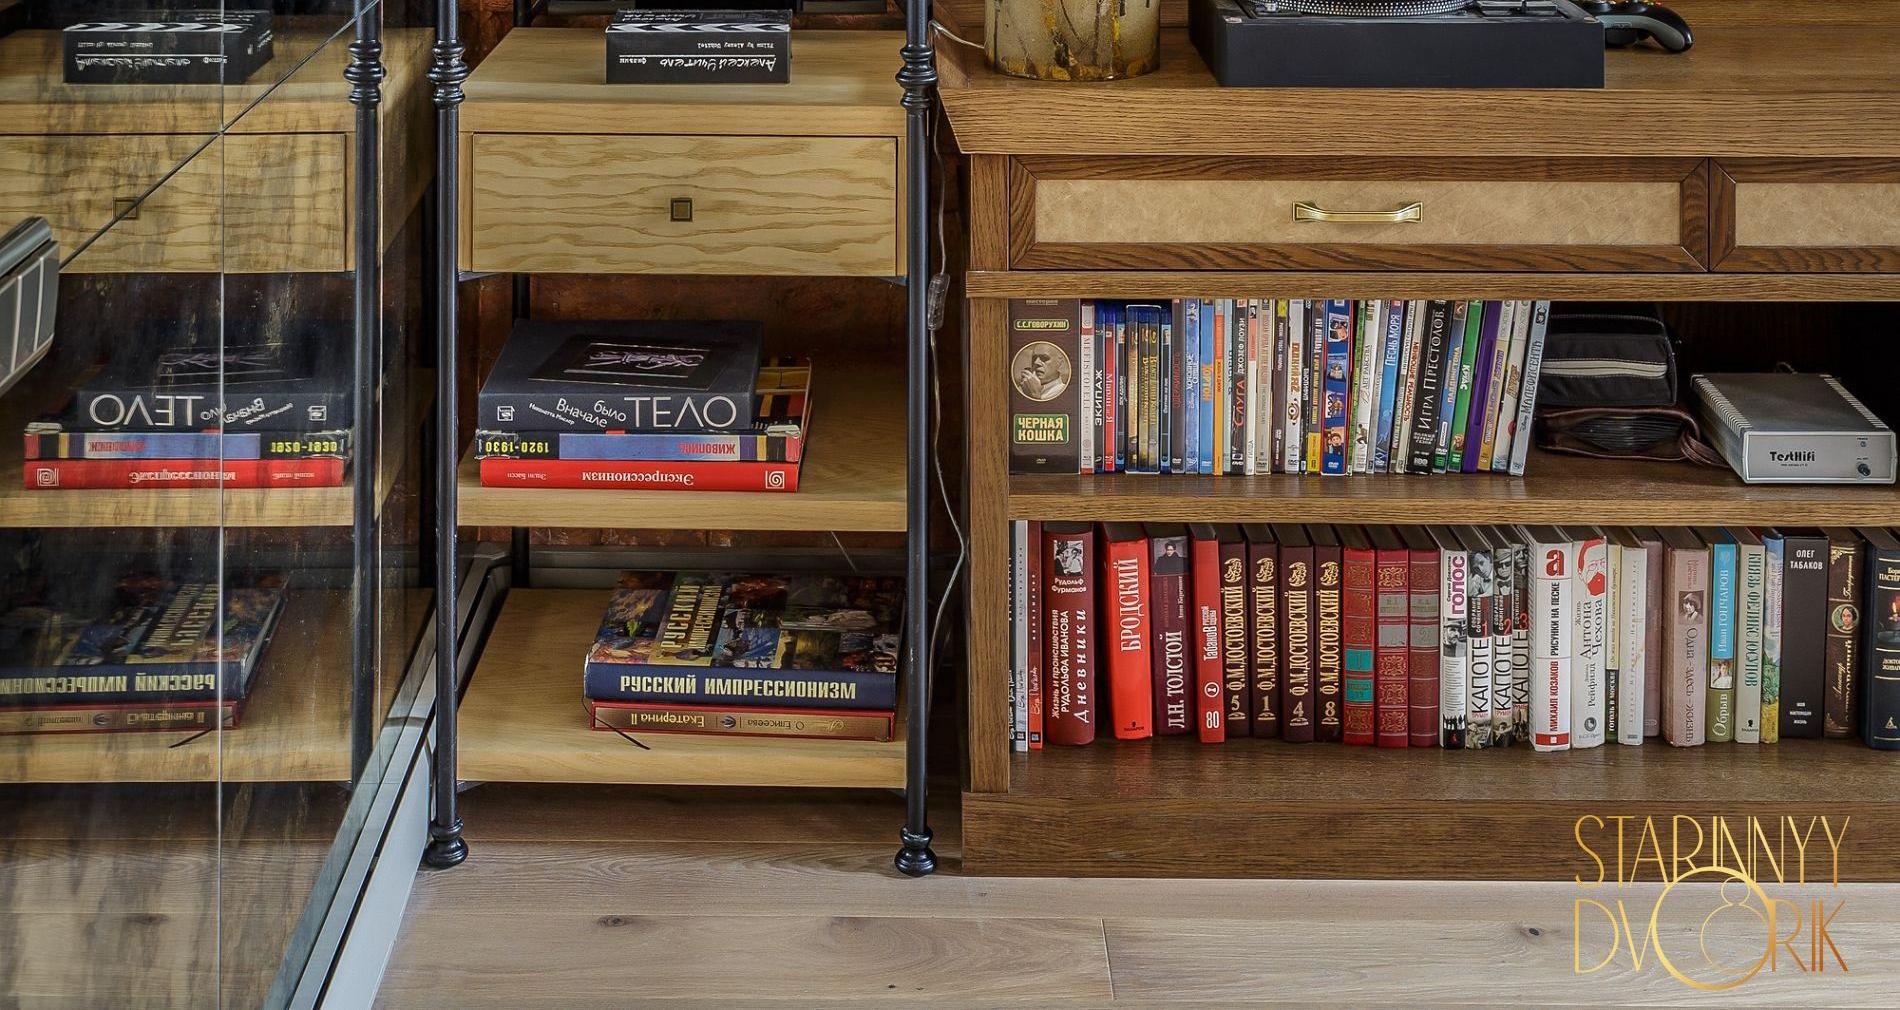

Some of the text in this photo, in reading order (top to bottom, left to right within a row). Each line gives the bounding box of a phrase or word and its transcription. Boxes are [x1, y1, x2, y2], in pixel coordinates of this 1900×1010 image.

[659, 57, 777, 72] Алексей Учитель
[1385, 314, 1401, 366] ПЕСНЬ МОРЯ
[1082, 337, 1094, 413] MEFISTOFELE
[1186, 353, 1194, 391] ХОЛОДНОЕ
[1233, 317, 1245, 427] СЛУГА ДЖОЗЕФ ЛОУЗИ
[1362, 344, 1371, 375] РАБСТВА
[1447, 346, 1460, 403] ПАДДИНГТОНА
[1094, 369, 1103, 427] ЭКИПАЖ
[1202, 363, 1214, 401] ХОРТОН
[556, 398, 608, 429] Вначале
[593, 399, 627, 423] было
[624, 395, 737, 428] ТЕЛО
[1403, 381, 1414, 422] РЕАЛЬНОСТЬ
[1418, 394, 1435, 429] ИГРА
[1018, 417, 1063, 429] ЧЕРНАЯ
[1018, 429, 1064, 441] КОШКА
[485, 441, 550, 454] 1920-1930
[1769, 451, 1816, 462] TestHifi
[582, 471, 695, 486] Экспрессионизм
[1789, 560, 1823, 570] ТАБАКОВ
[1796, 549, 1816, 559] ОЛЕГ
[1451, 555, 1466, 615] ГОЛОС
[660, 584, 700, 649] РУССКИЙ
[688, 584, 723, 650] ИМПРЕССИОНИЗМ
[1113, 557, 1145, 652] БРОДСКИЙ
[1519, 613, 1528, 630] 3
[1550, 582, 1560, 656] РИСУНКИ НА ПЕСКЕ
[1717, 570, 1729, 652] Иван ГОНЧАРОВ
[1744, 552, 1762, 687] КНЯЗЬ ФЕЛИКС ЮСУПОВ
[1051, 609, 1059, 679] происшествия
[1482, 622, 1489, 637] 1
[1504, 618, 1512, 635] 2
[1579, 601, 1592, 660] Антона
[1591, 599, 1603, 656] Чехова
[1061, 610, 1071, 713] РУДОЛЬФА ИВАНОВА
[1073, 609, 1089, 723] Дневники
[1159, 630, 1185, 729] Л.Н. ТОЛСТОЙ
[1471, 637, 1490, 713] КАПОТЕ
[1494, 635, 1512, 711] КАПОТЕ
[1512, 630, 1529, 704] КАПОТЕ
[620, 674, 857, 700] РУССКИЙ ИМПРЕССИОНИЗМ
[1550, 661, 1559, 732] МИХАИЛ КОЗАКОВ
[1588, 663, 1598, 707] Рейфилд
[1608, 671, 1616, 699] МОСКВЕ
[641, 714, 705, 727] Екатерина
[1051, 688, 1060, 719] Жизнь
[1205, 711, 1220, 729] 80
[1231, 695, 1241, 712] 5
[1263, 695, 1270, 712] 1
[1292, 701, 1304, 717] 4
[1325, 701, 1336, 717] 8
[1608, 706, 1616, 732] ГОГОЛЬ
[1712, 693, 1730, 736] Обрыв
[747, 719, 792, 730] Елисеева
